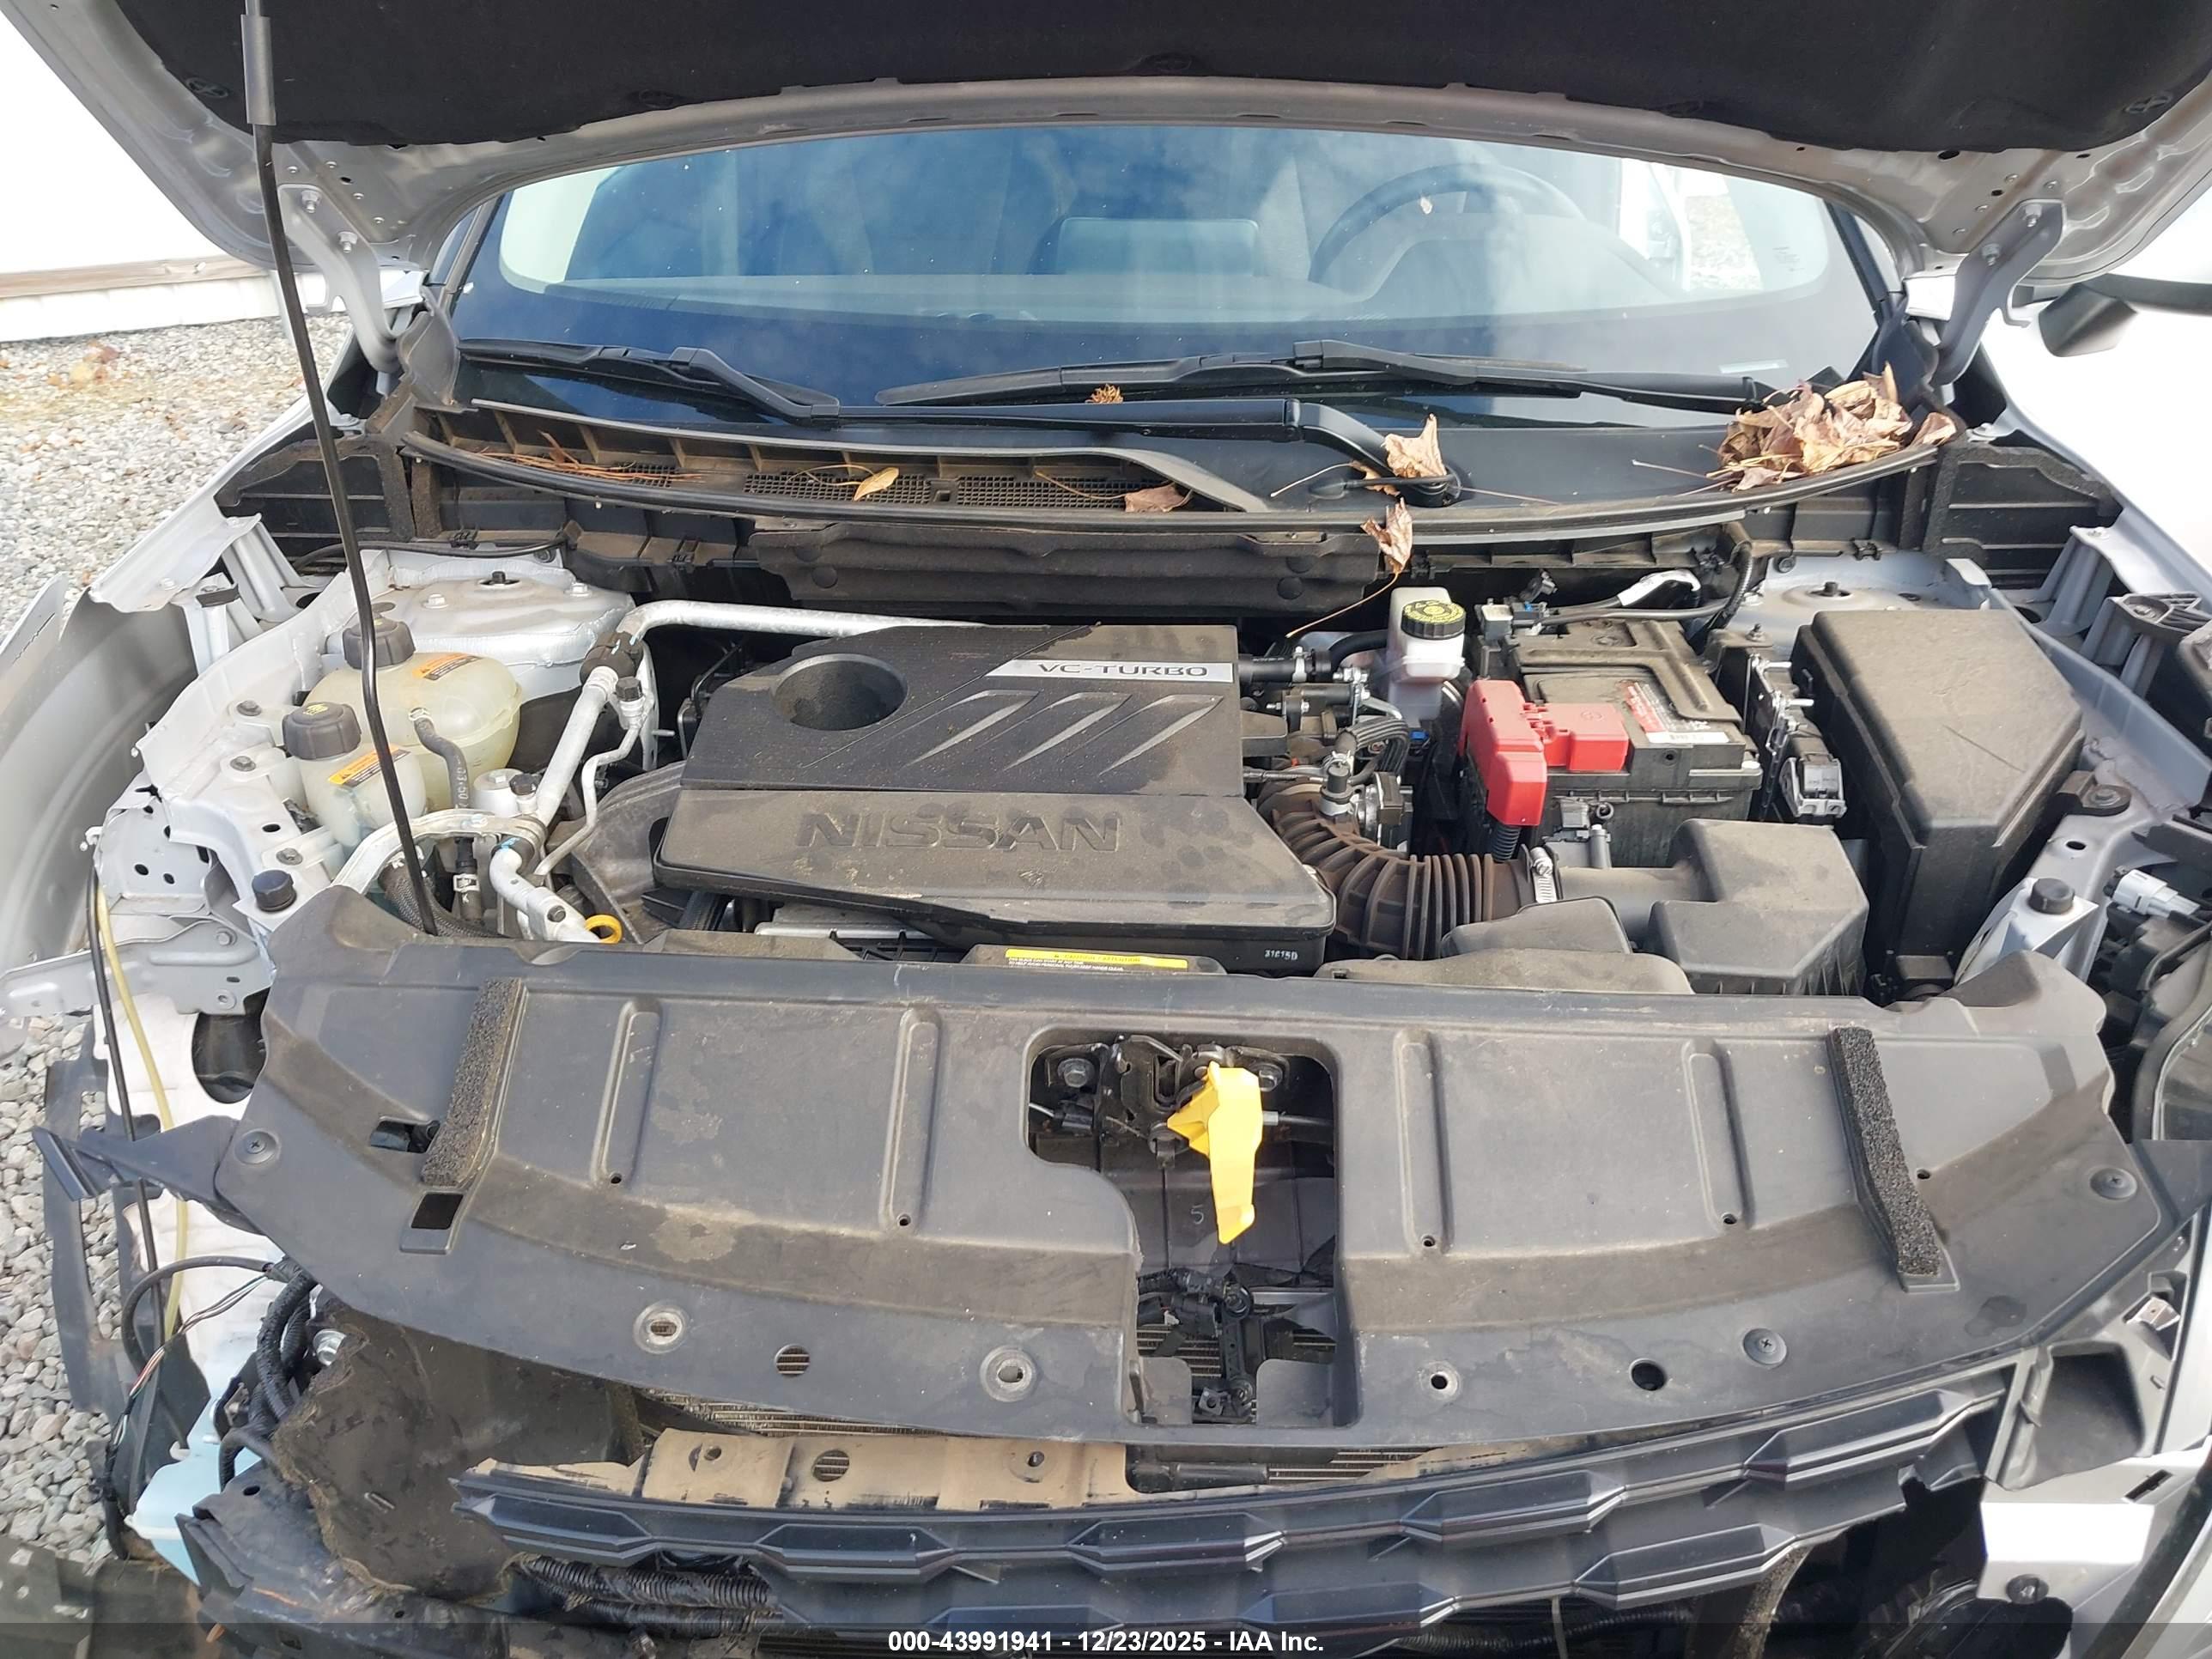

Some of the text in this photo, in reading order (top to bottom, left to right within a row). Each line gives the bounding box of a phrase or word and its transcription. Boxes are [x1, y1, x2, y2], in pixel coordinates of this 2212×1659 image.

[1037, 663, 1208, 678] VC-TURBO
[795, 812, 1121, 853] NISSAN
[1190, 1203, 1205, 1225] 5
